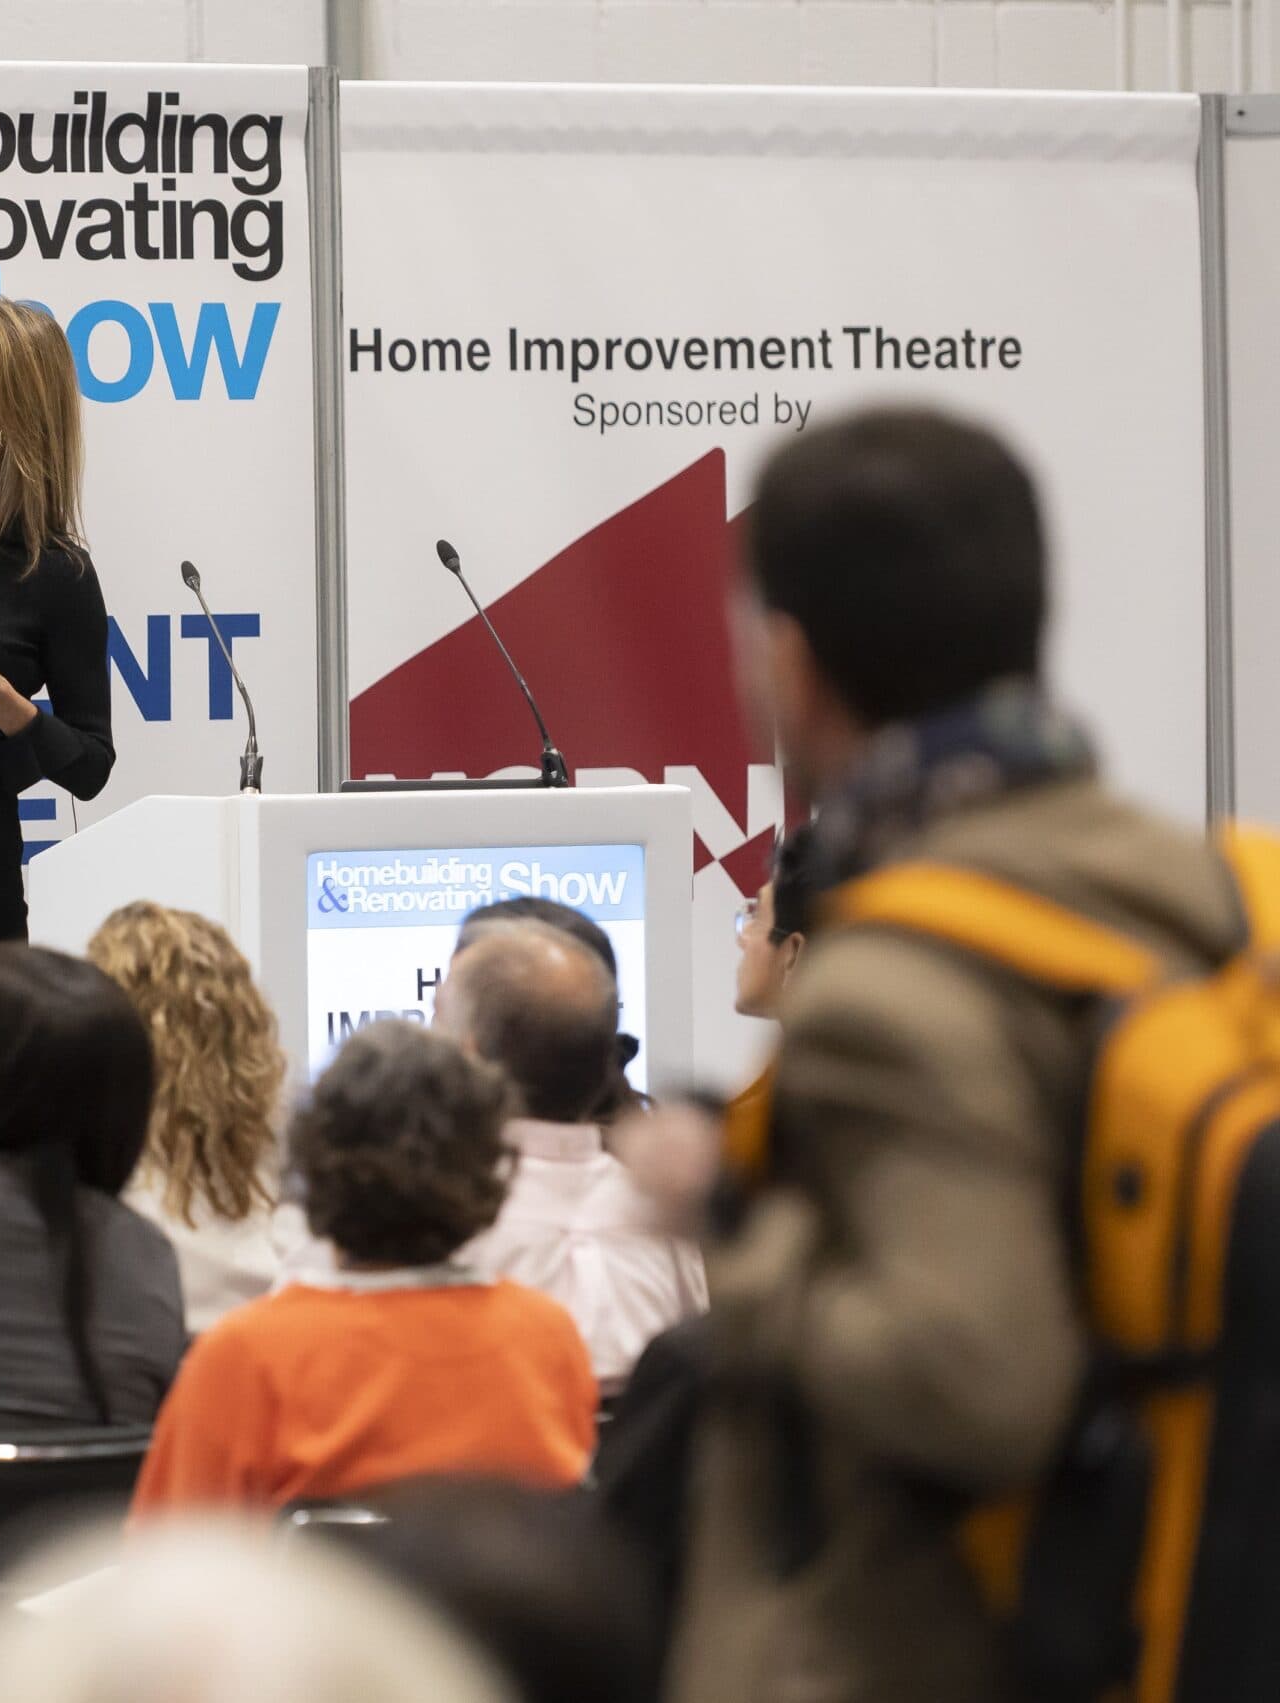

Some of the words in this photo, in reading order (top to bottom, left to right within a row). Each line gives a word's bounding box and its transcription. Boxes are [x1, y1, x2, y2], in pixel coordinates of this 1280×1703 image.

[349, 328, 491, 373] Home
[509, 327, 834, 382] Improvement
[842, 326, 1023, 370] Theatre
[573, 393, 759, 434] Sponsored
[773, 392, 813, 432] by
[316, 857, 493, 888] Homebuilding
